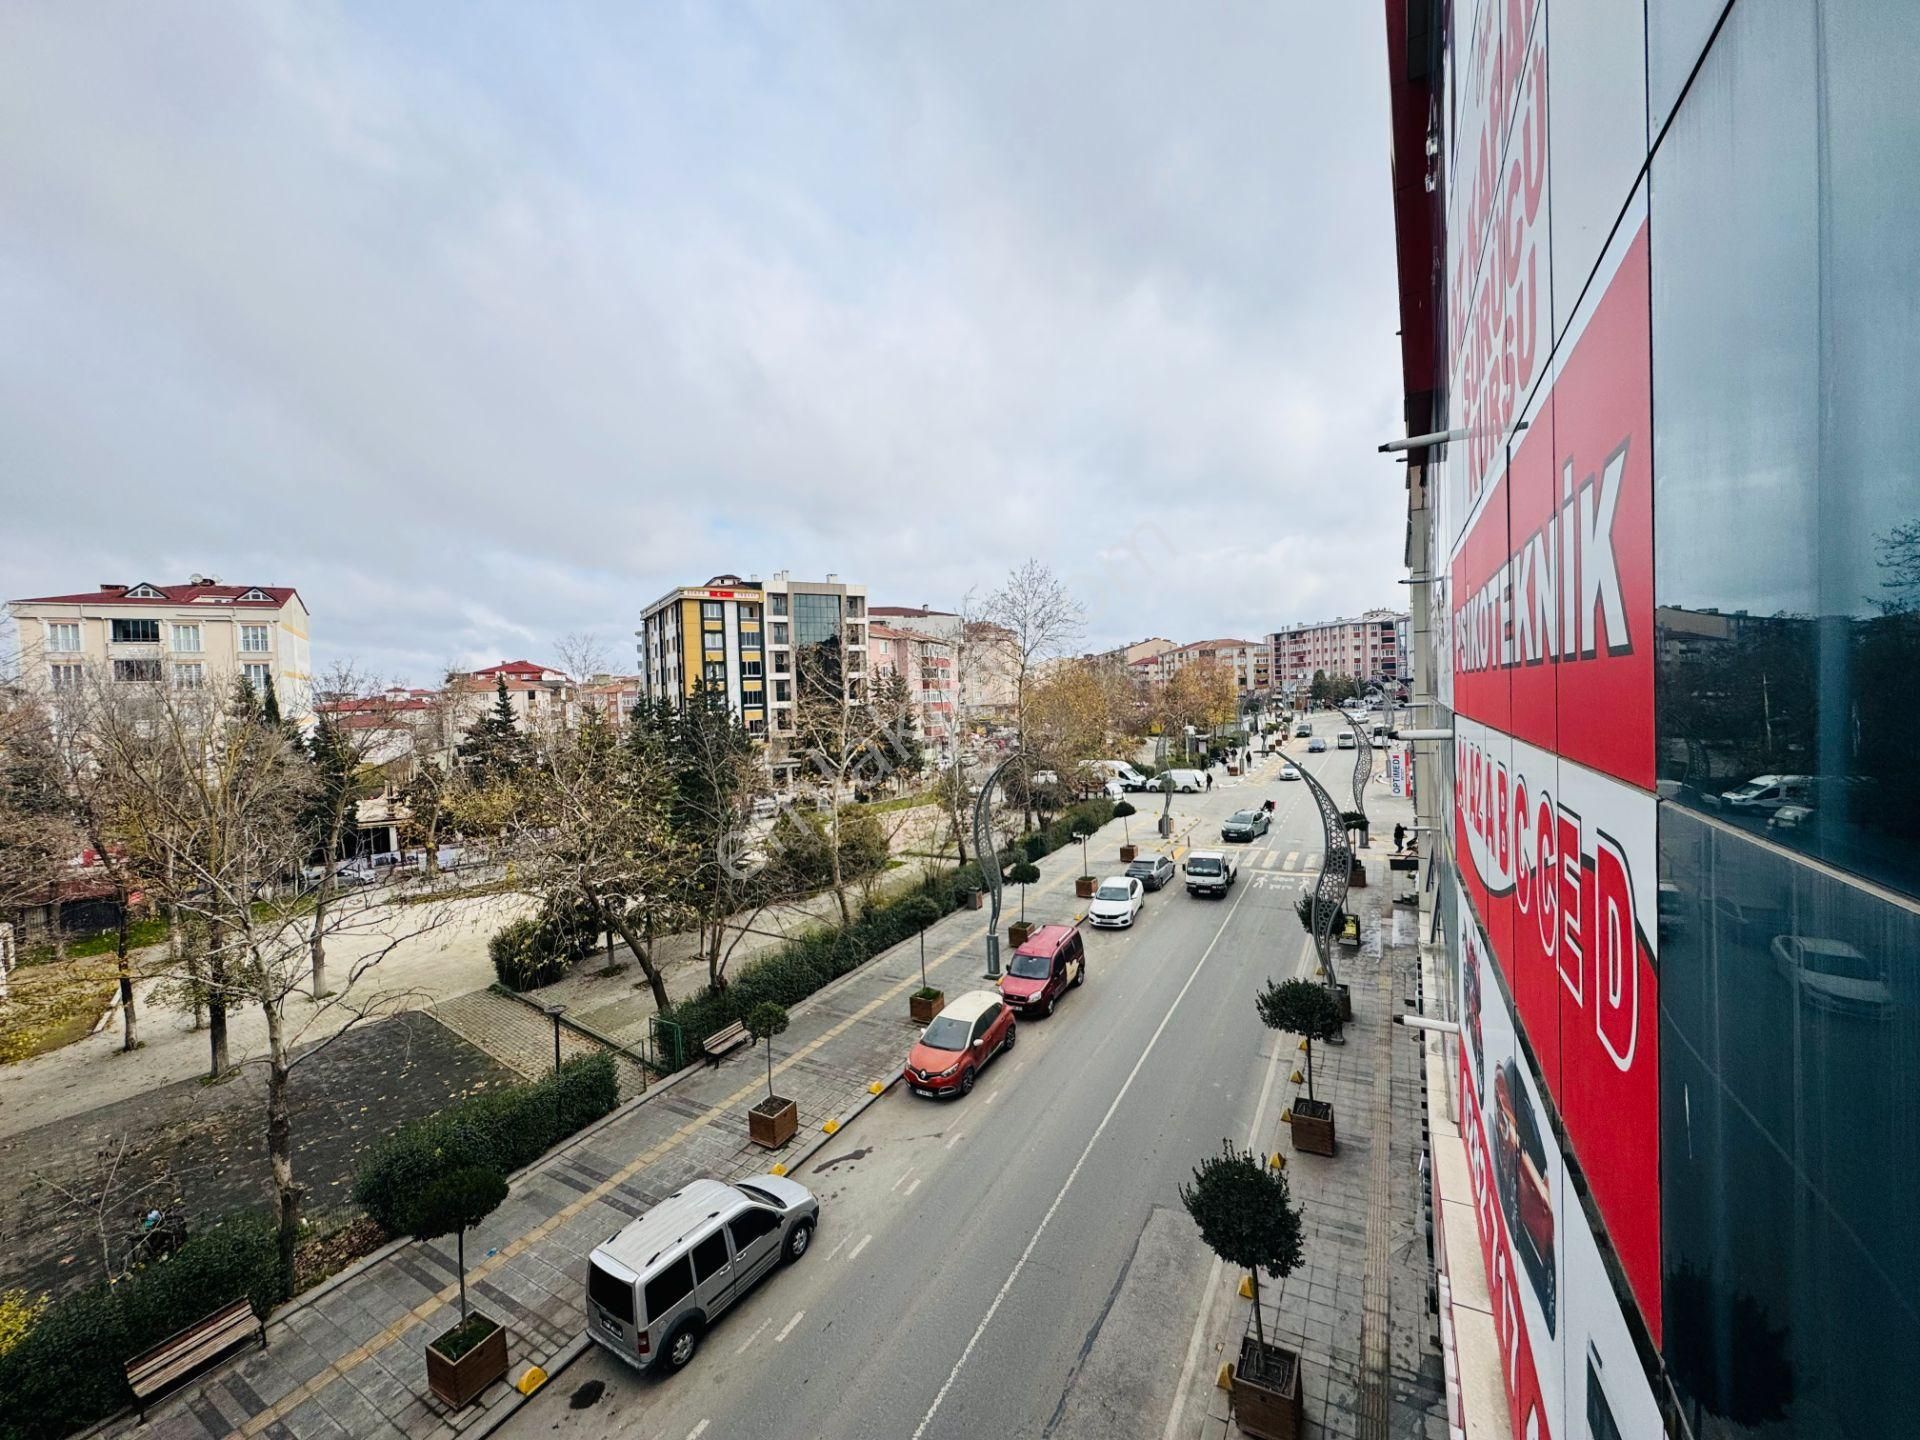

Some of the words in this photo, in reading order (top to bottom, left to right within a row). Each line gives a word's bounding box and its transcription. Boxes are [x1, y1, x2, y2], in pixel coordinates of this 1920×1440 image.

[1464, 40, 1546, 429] SÜRÜCÜ
[1468, 241, 1537, 504] KURSU
[1455, 433, 1634, 675] PSİKOTEKNİK
[1470, 742, 1483, 839] A2
[1485, 753, 1496, 860] A
[1497, 760, 1509, 877] B
[1514, 773, 1530, 914] C
[1596, 828, 1639, 1072] D
